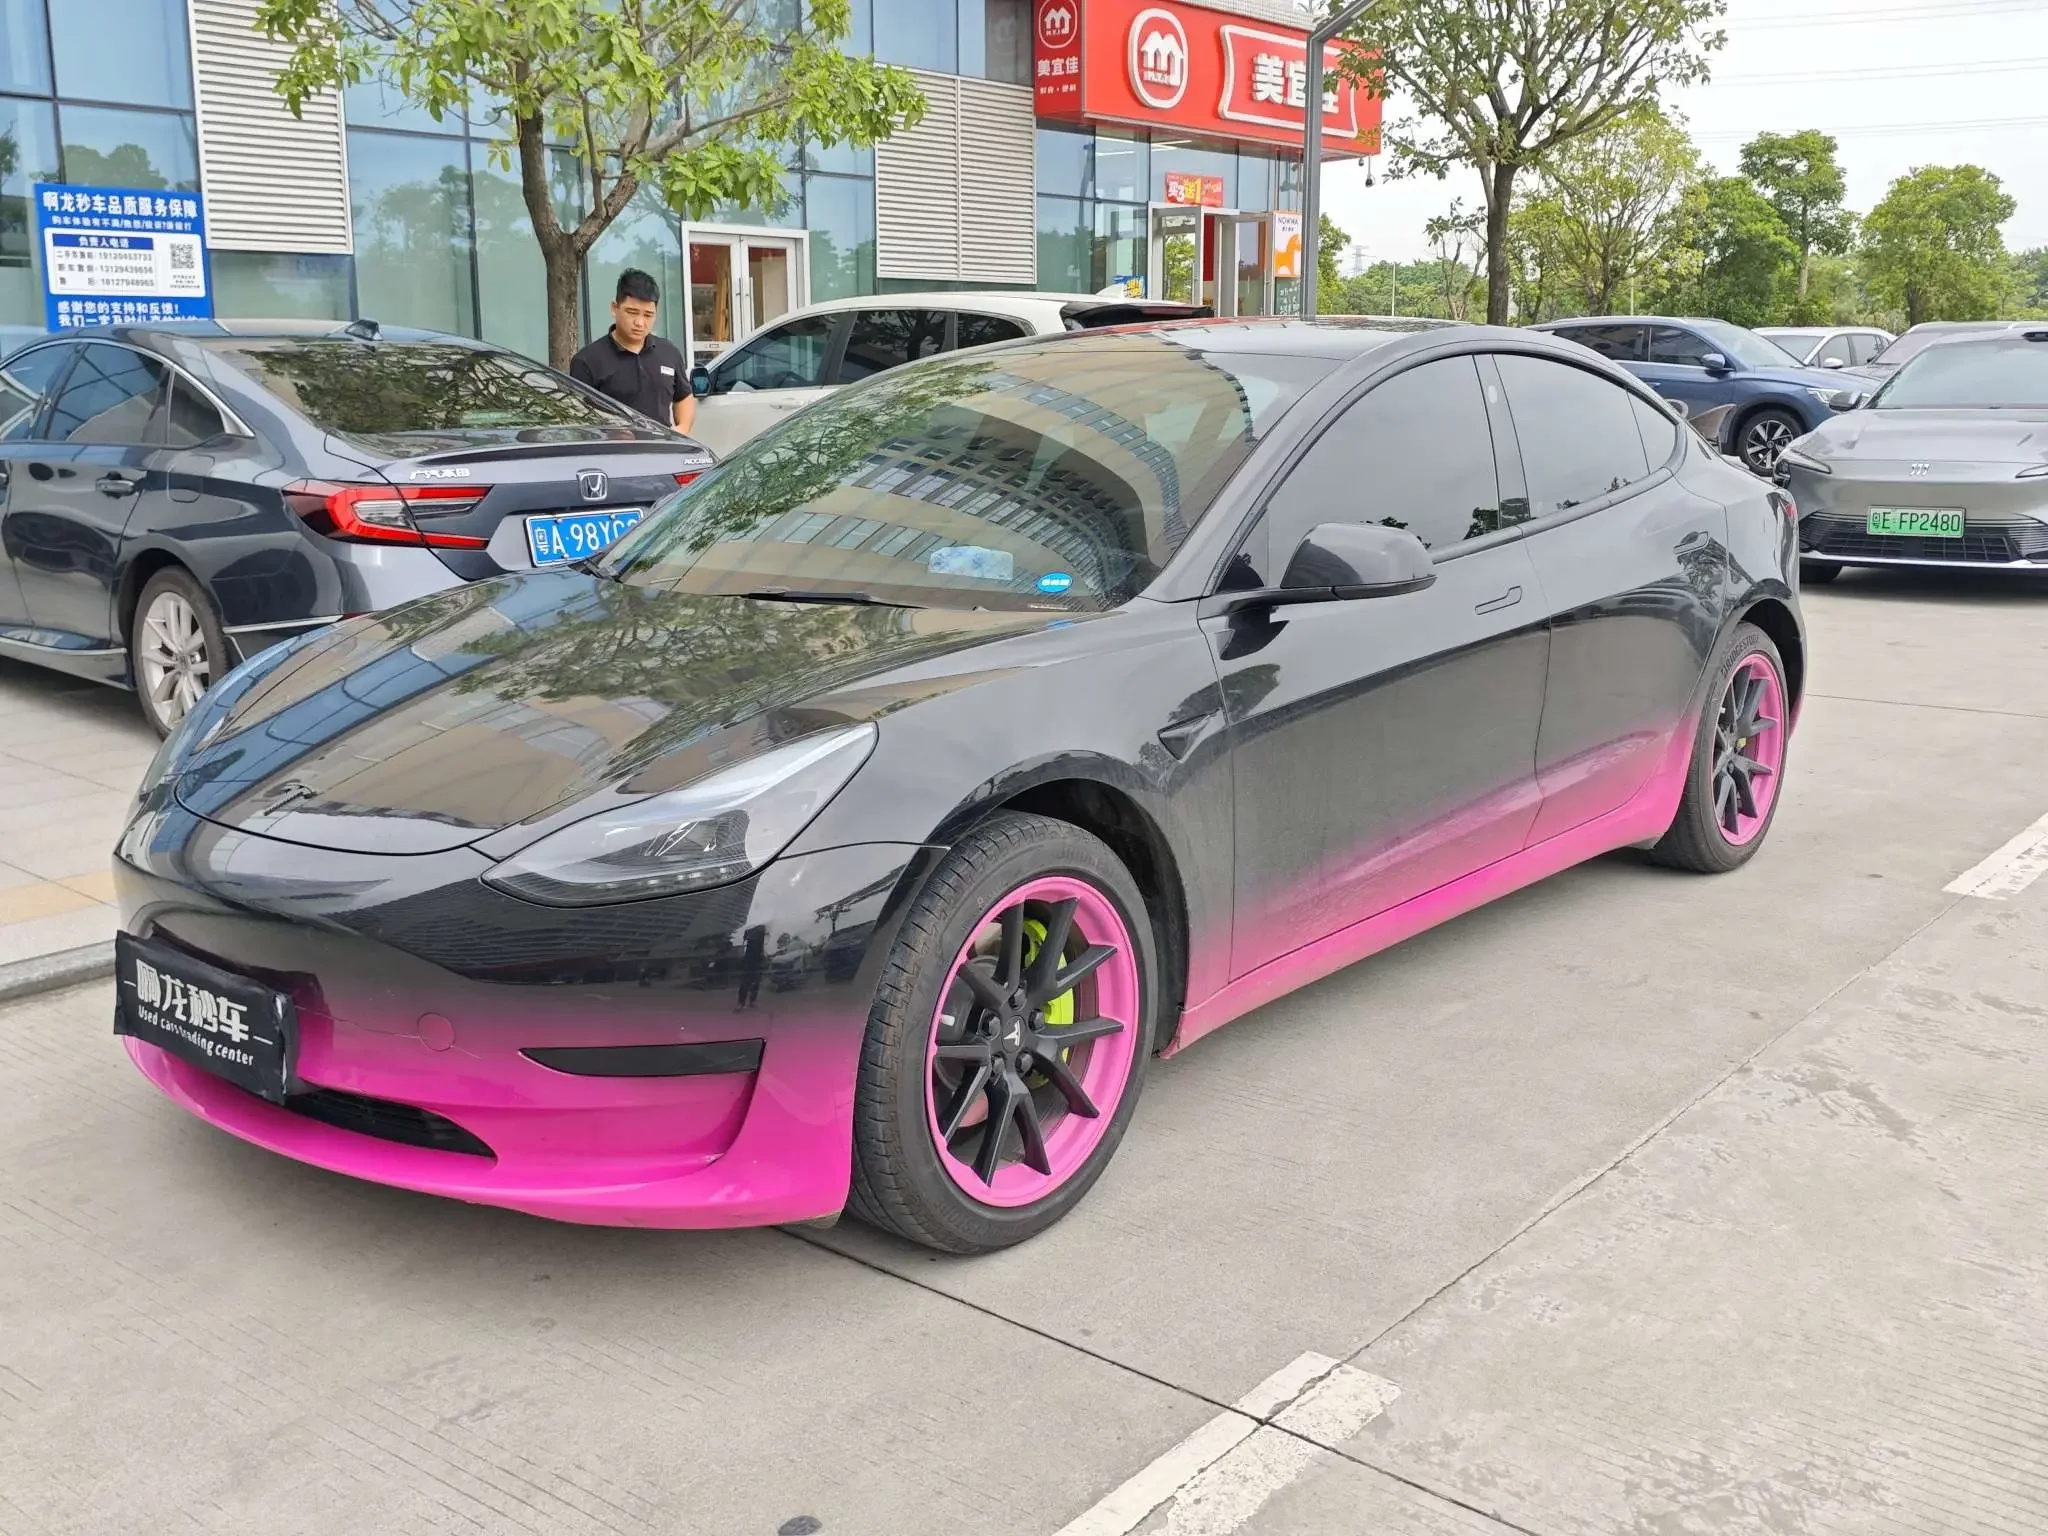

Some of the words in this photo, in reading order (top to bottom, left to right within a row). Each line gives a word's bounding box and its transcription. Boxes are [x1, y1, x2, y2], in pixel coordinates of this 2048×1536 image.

[1037, 56, 1079, 77] 美宜佳
[138, 1005, 158, 1026] Used
[215, 1044, 254, 1066] center
